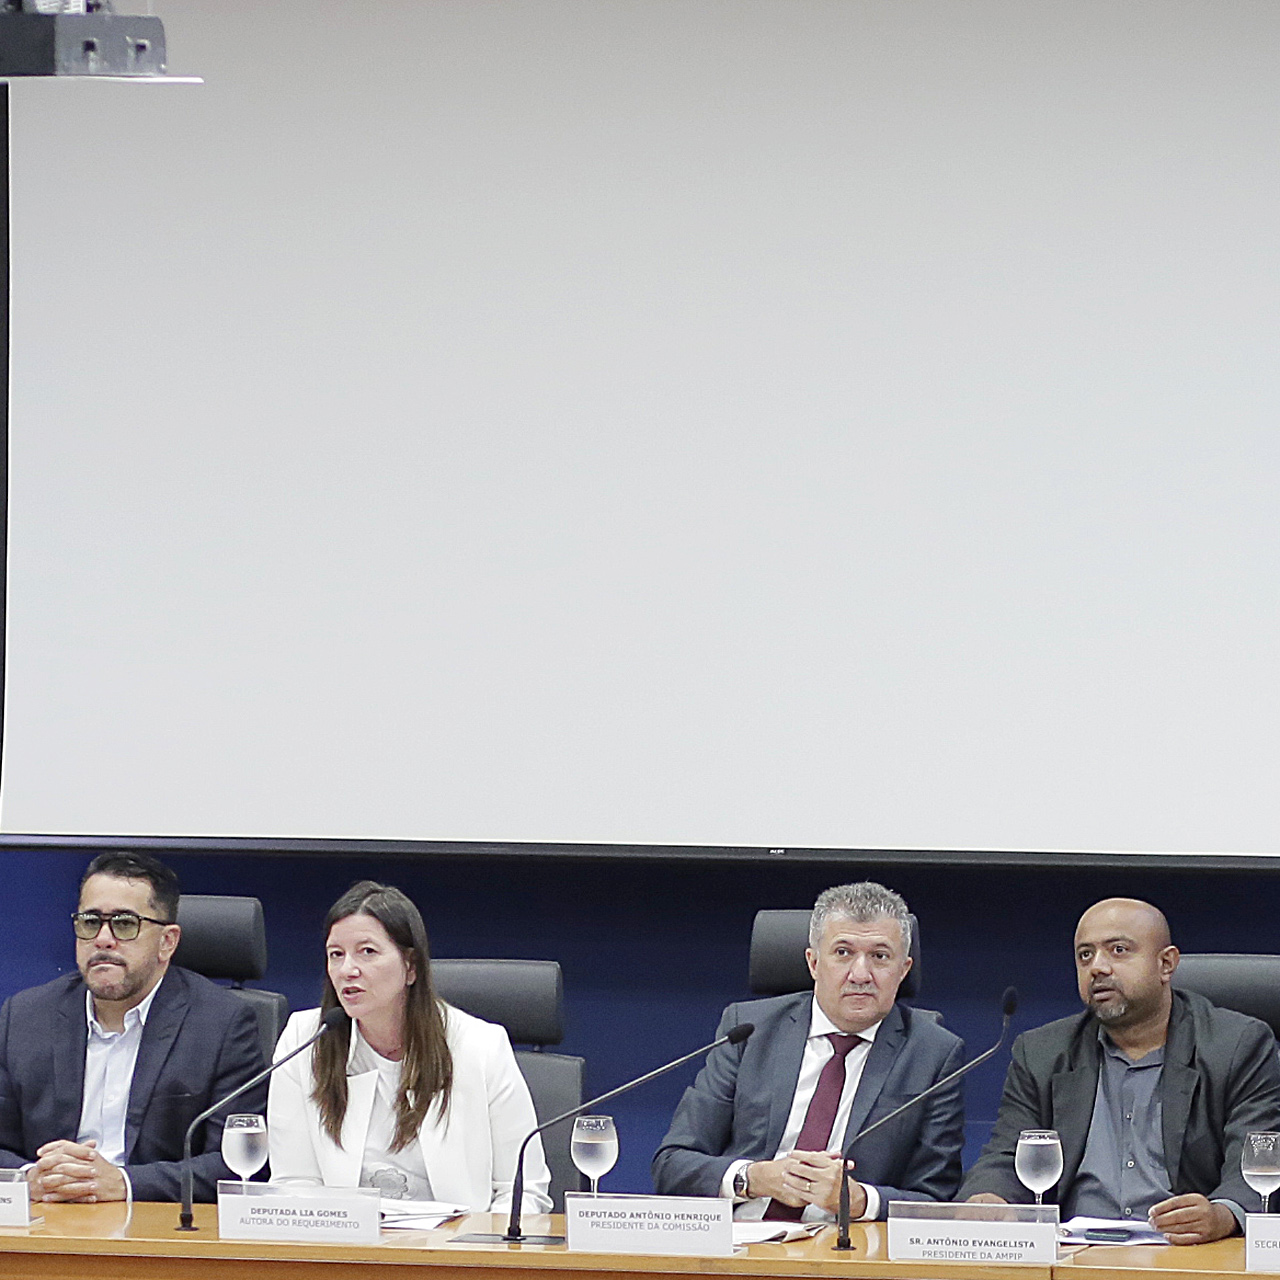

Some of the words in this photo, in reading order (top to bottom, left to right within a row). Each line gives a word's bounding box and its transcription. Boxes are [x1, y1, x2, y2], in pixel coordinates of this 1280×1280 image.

[251, 1208, 297, 1216] DEPUTADA
[579, 1211, 627, 1219] DEPUTADO
[629, 1210, 671, 1220] ANTÔNIO
[675, 1214, 721, 1222] HENRIQUE
[239, 1218, 274, 1226] AUTORA
[292, 1220, 359, 1229] REQUERIMENTO
[591, 1221, 644, 1230] PRESIDENTE
[648, 1222, 660, 1230] DA
[662, 1222, 710, 1232] COMISSÃO
[927, 1237, 969, 1247] ANTÔNIO
[972, 1240, 1035, 1249] EVANGELISTA
[922, 1250, 977, 1259] PRESIDENTE
[980, 1252, 992, 1260] DA
[995, 1252, 1023, 1260] AMPIP
